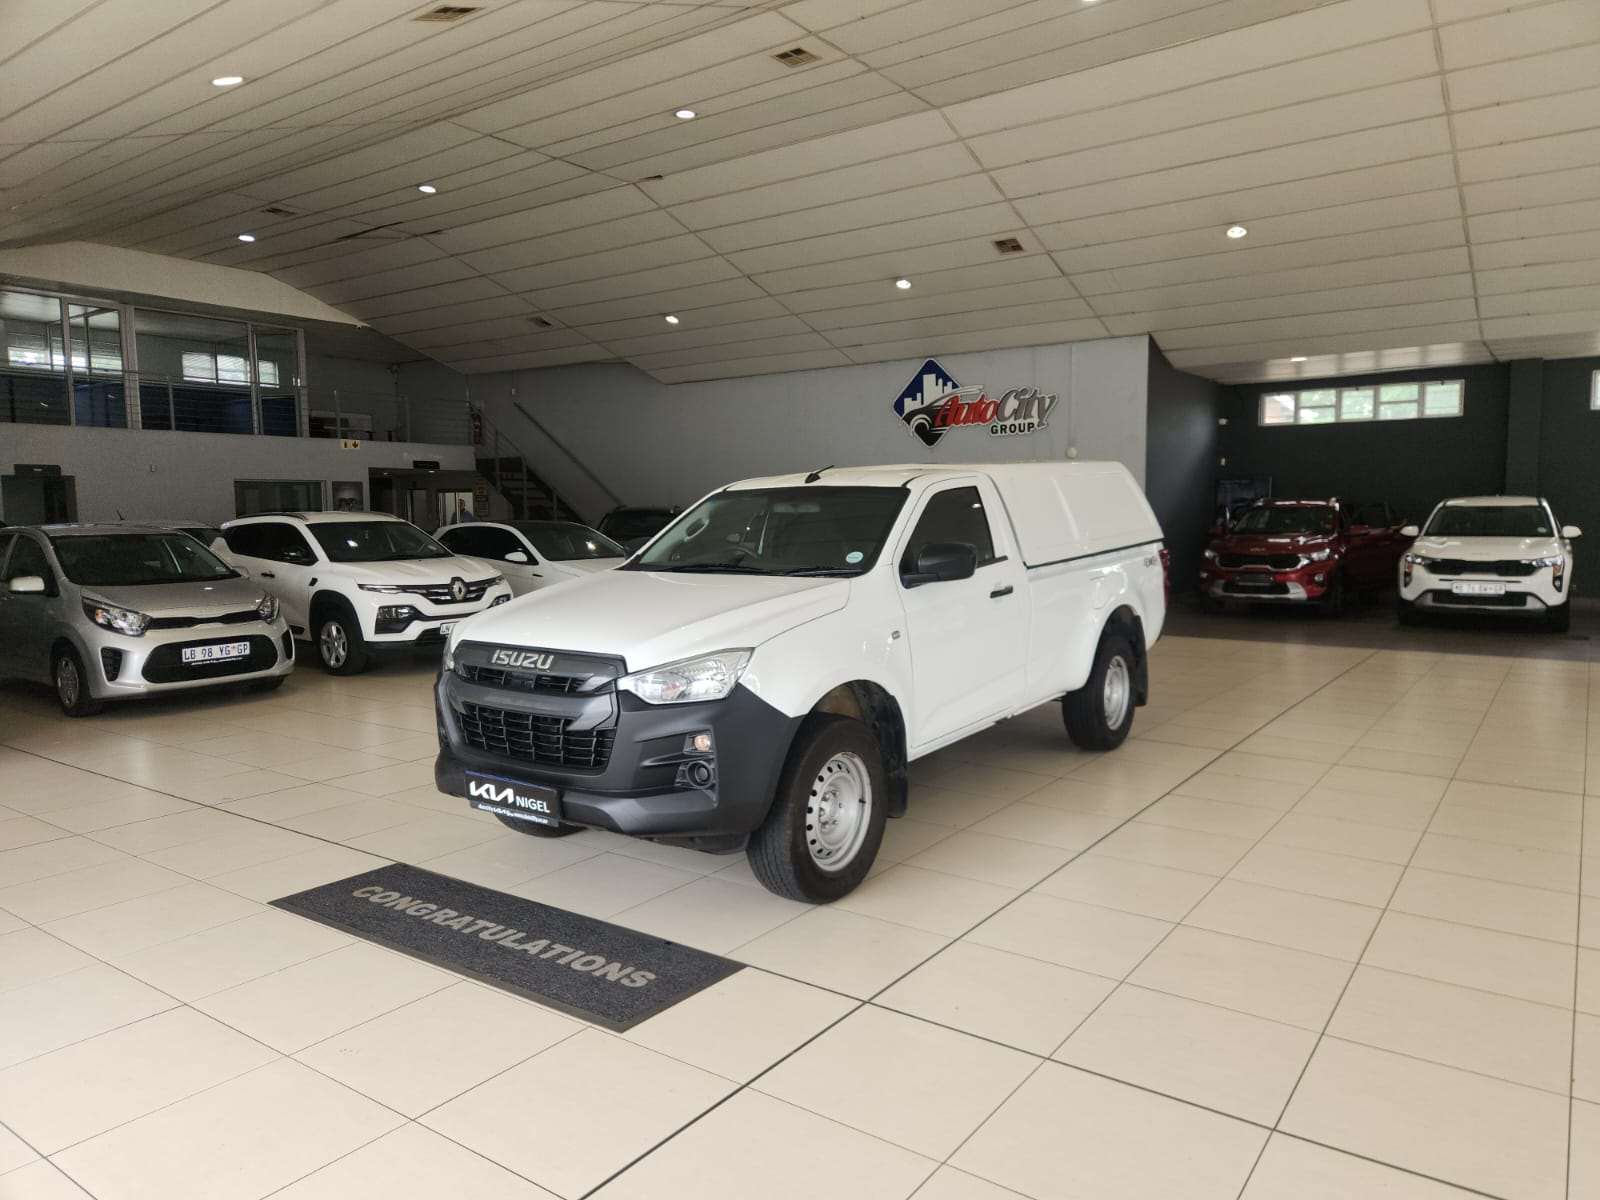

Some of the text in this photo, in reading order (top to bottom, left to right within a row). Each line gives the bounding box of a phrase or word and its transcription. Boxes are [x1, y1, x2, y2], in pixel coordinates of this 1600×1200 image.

[990, 422, 1035, 435] GROUP
[184, 649, 196, 660] LB
[201, 647, 213, 658] 98
[237, 643, 248, 654] GP
[491, 649, 554, 670] ISUZU
[469, 780, 550, 813] KIA NIGEL
[352, 886, 657, 988] CONGRATULATIONS
